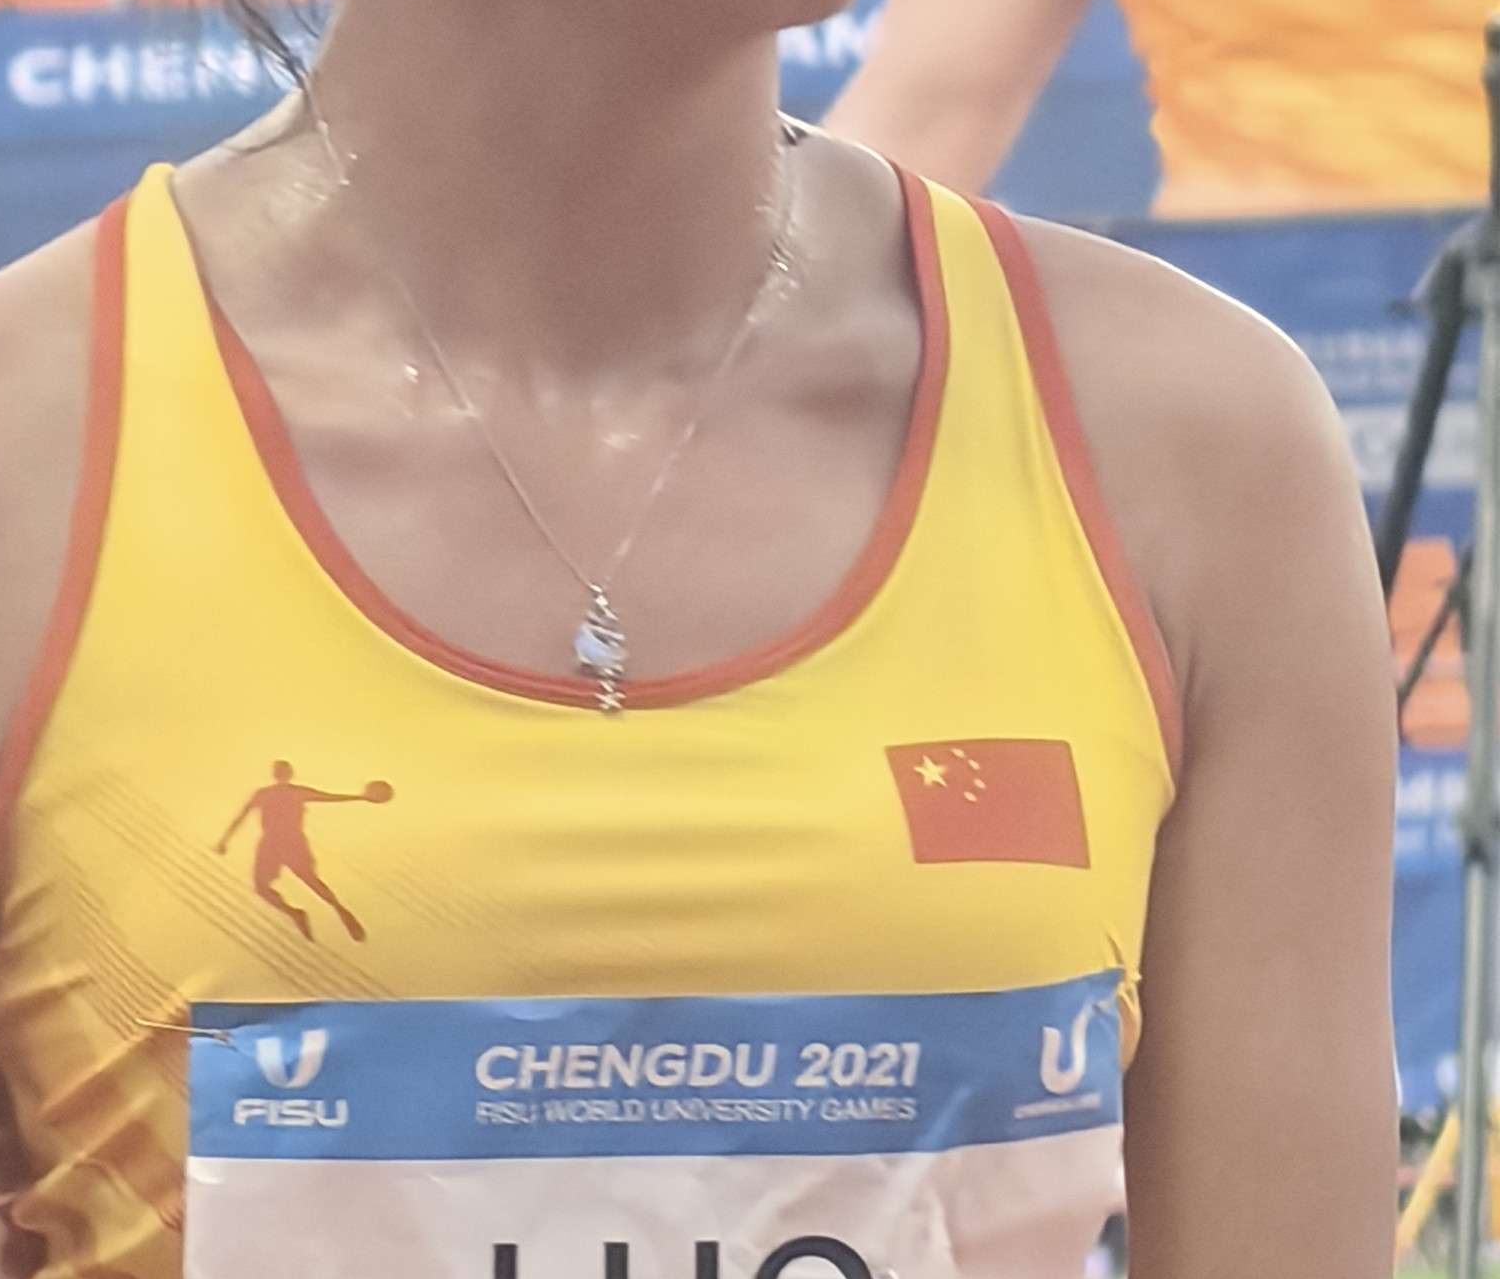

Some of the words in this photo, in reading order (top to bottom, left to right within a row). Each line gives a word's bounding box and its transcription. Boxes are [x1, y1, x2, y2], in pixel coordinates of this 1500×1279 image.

[7, 42, 302, 107] CHEN
[475, 1042, 778, 1091] CHENGDU
[795, 1041, 922, 1089] 2021
[233, 1098, 349, 1128] FISU
[543, 1099, 645, 1122] WORLD
[651, 1098, 813, 1122] UNIVERSITY
[819, 1097, 918, 1121] GAMES
